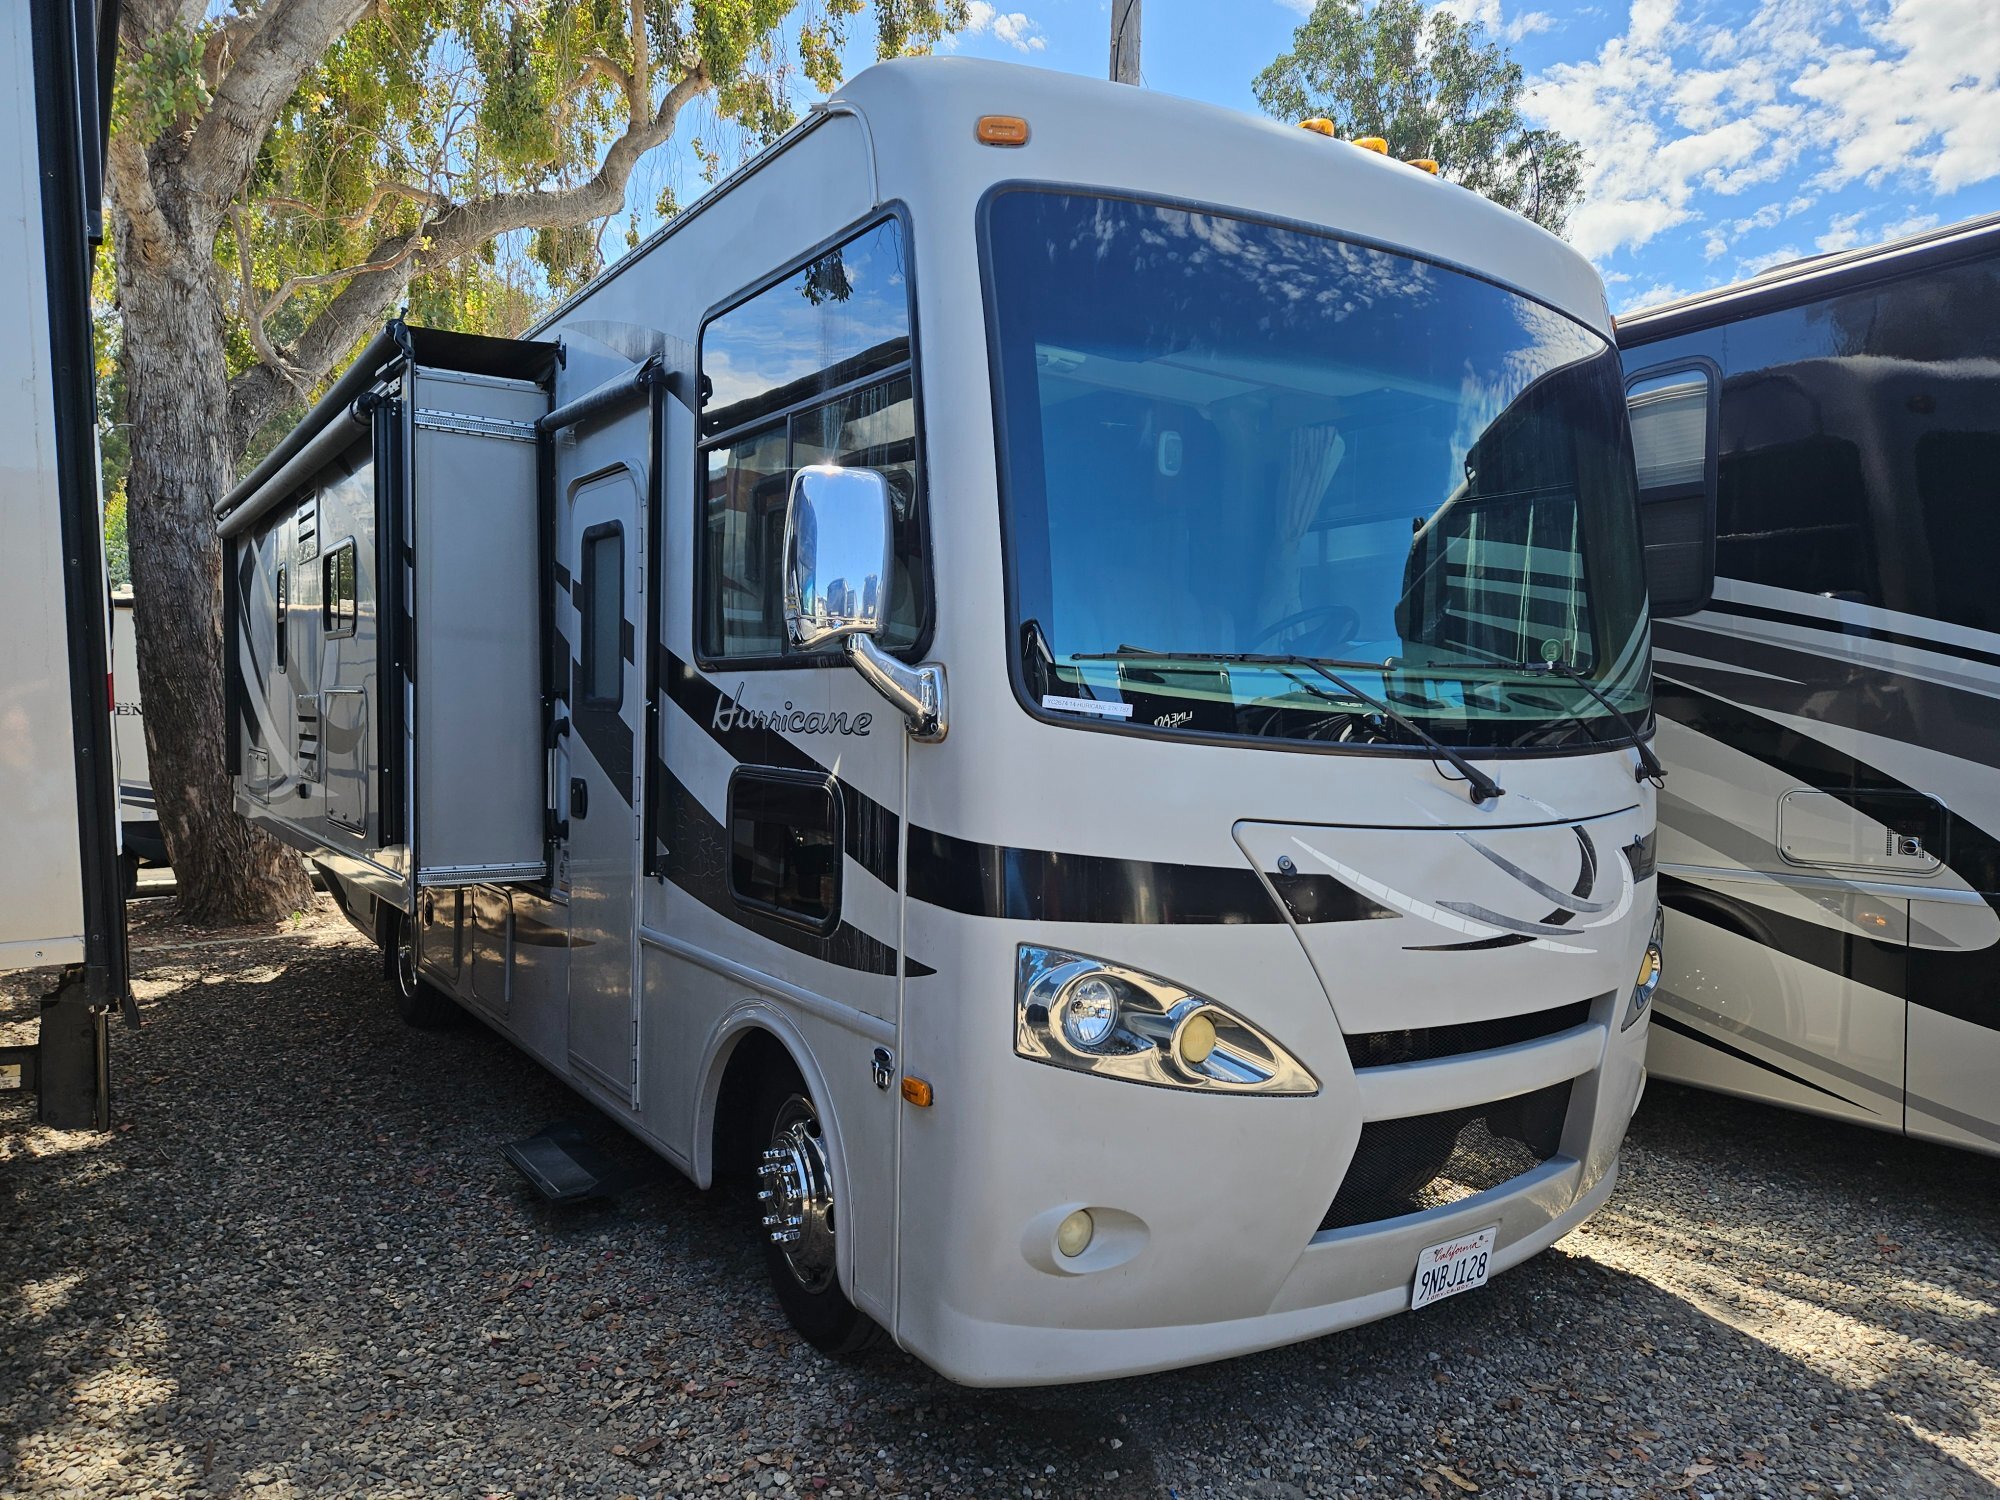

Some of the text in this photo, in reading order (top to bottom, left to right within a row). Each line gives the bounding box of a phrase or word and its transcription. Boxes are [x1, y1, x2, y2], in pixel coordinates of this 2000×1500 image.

[712, 681, 873, 736] Hurricane
[1434, 1240, 1481, 1262] California
[1419, 1252, 1488, 1301] 9NBJ128
